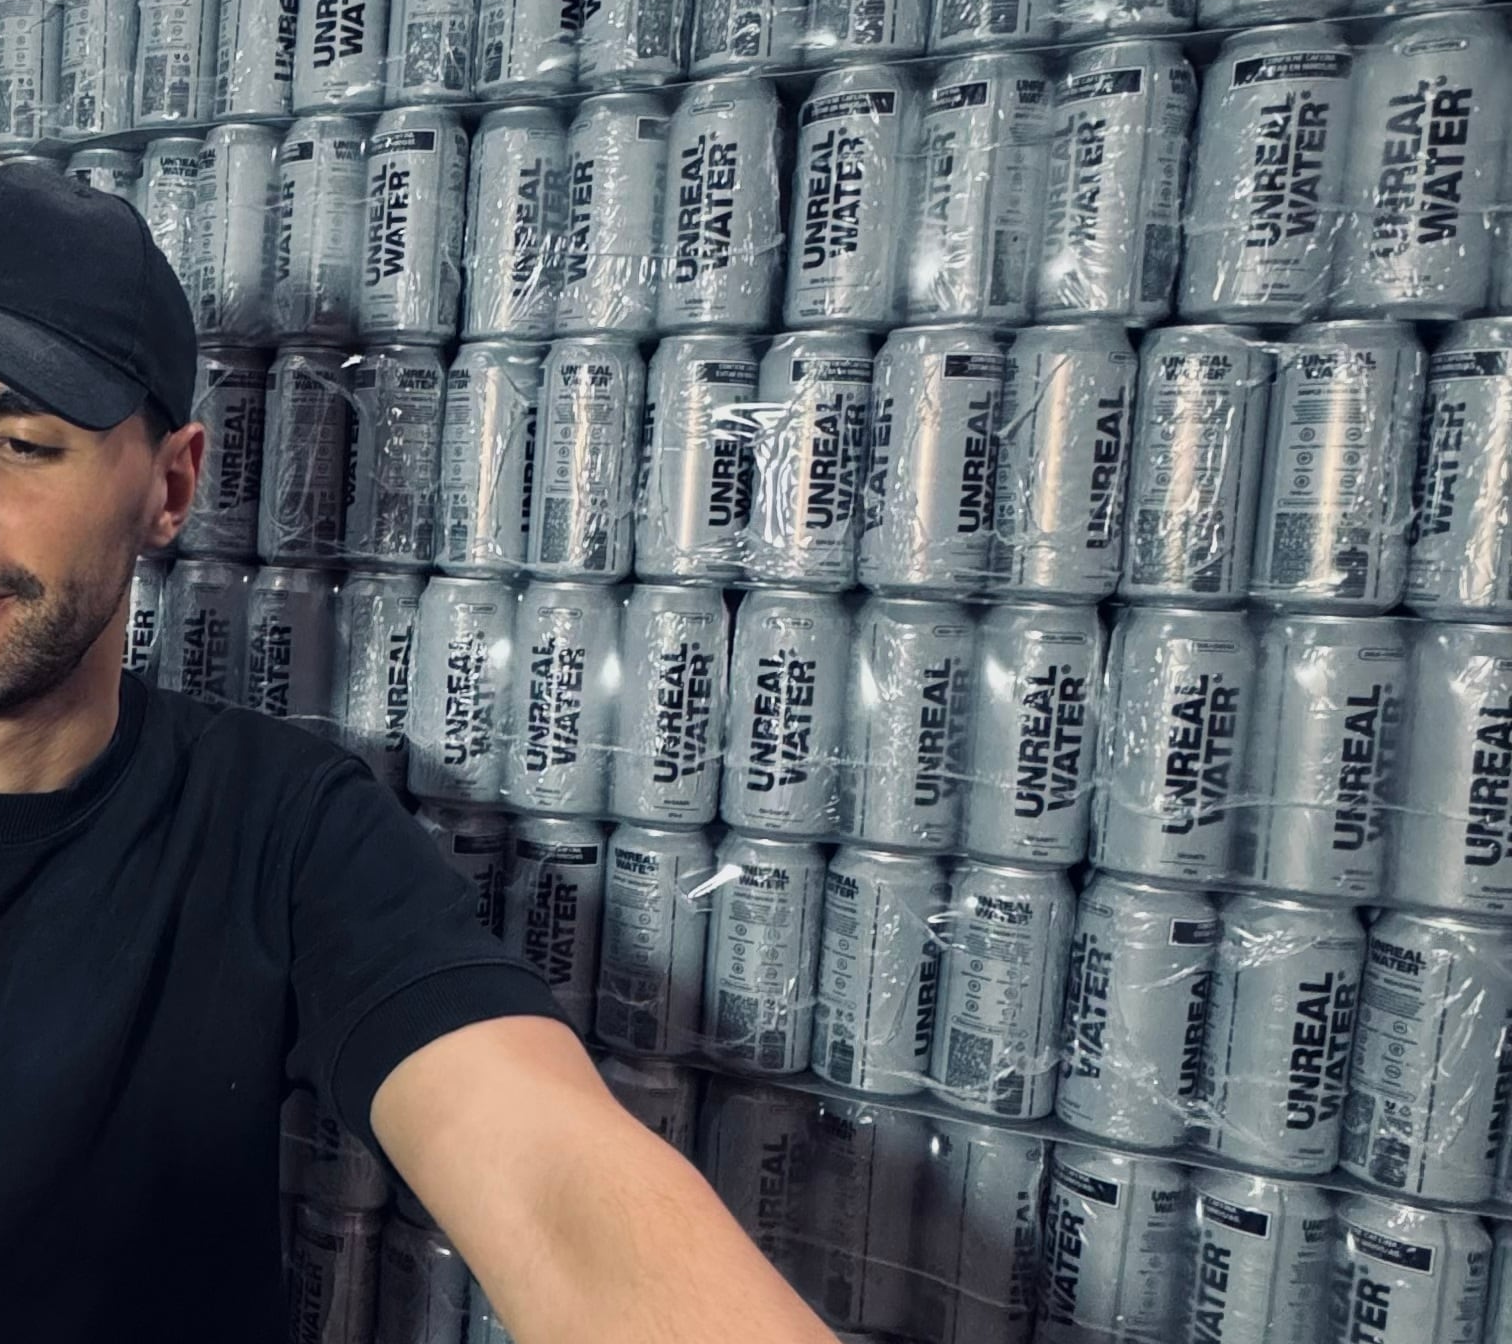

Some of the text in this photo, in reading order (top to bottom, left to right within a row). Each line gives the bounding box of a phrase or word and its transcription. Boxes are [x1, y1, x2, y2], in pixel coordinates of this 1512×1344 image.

[365, 163, 388, 287] UNREAL
[384, 171, 410, 277] WATER
[568, 160, 594, 284] WATER
[676, 134, 706, 284] UNREAL
[702, 141, 738, 272] WATER
[803, 129, 836, 271] UNREAL
[830, 137, 864, 258] WATER
[1246, 105, 1293, 248] UNREAL
[1287, 102, 1330, 237] WATER
[1418, 87, 1473, 244] WATER
[220, 398, 247, 510] UNREAL
[806, 393, 843, 529] UNREAL
[837, 403, 866, 526] WATER
[958, 396, 989, 533] UNREAL
[1087, 386, 1124, 548] UNREAL
[384, 626, 413, 752] UNREAL
[526, 636, 556, 773] UNREAL
[552, 648, 586, 766] WATER
[653, 643, 688, 783] UNREAL
[682, 653, 714, 776] WATER
[747, 653, 785, 792] UNREAL
[779, 660, 816, 786] WATER
[914, 659, 951, 807] UNREAL
[1014, 666, 1057, 818] UNREAL
[1048, 676, 1085, 811] WATER
[1162, 673, 1209, 834] UNREAL
[1198, 687, 1240, 826] WATER
[1333, 684, 1381, 850] UNREAL
[549, 882, 579, 987] WATER
[1370, 938, 1426, 964] UNREAL
[1078, 948, 1112, 1078] WATER
[1287, 971, 1334, 1131] UNREAL
[1320, 980, 1358, 1122] WATER
[1052, 1216, 1087, 1327] WATER
